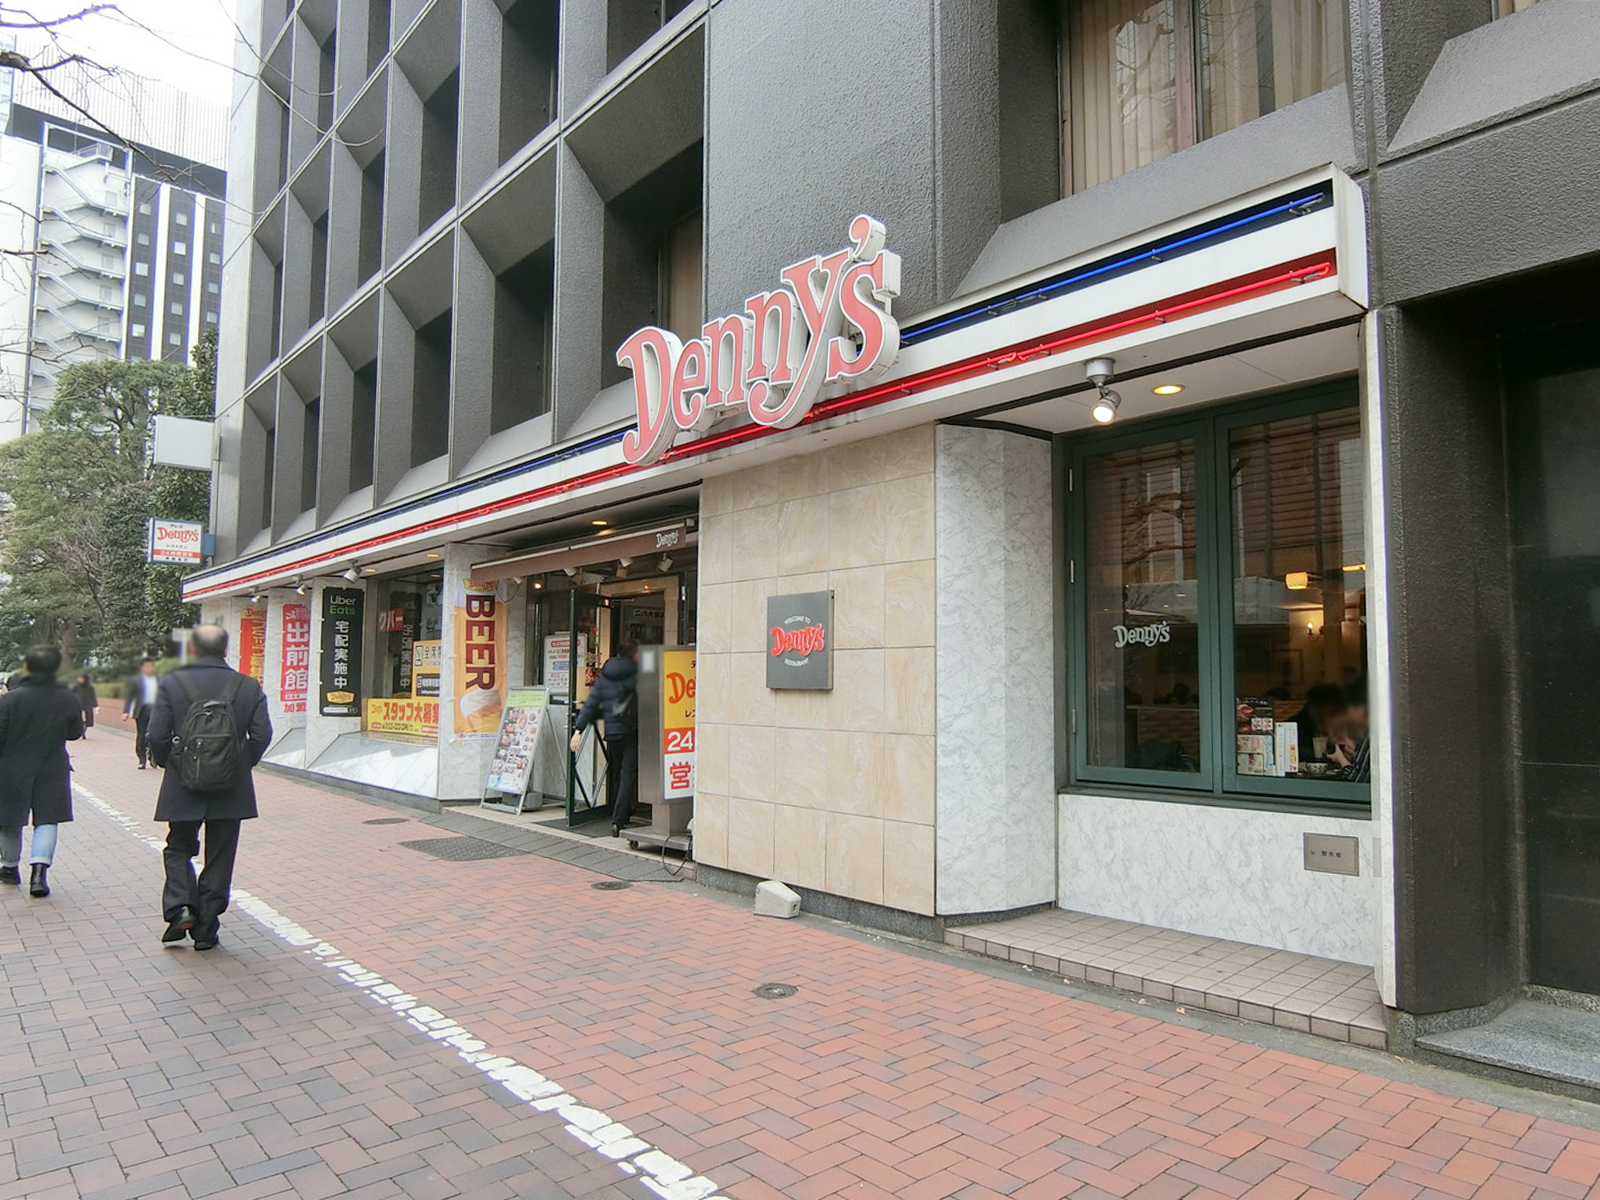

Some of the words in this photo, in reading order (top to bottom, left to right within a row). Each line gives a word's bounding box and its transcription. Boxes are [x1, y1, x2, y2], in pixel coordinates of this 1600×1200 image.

[616, 213, 898, 464] Denny's
[156, 526, 199, 543] Denny's
[329, 605, 356, 615] Eats
[330, 595, 356, 605] Uber
[466, 594, 496, 690] BEER
[770, 623, 825, 657] Denny's
[1112, 620, 1170, 648] Denny's
[284, 621, 309, 691] 出前館
[334, 620, 349, 690] 宅配実施中
[667, 731, 693, 751] 24
[670, 761, 692, 790] 営
